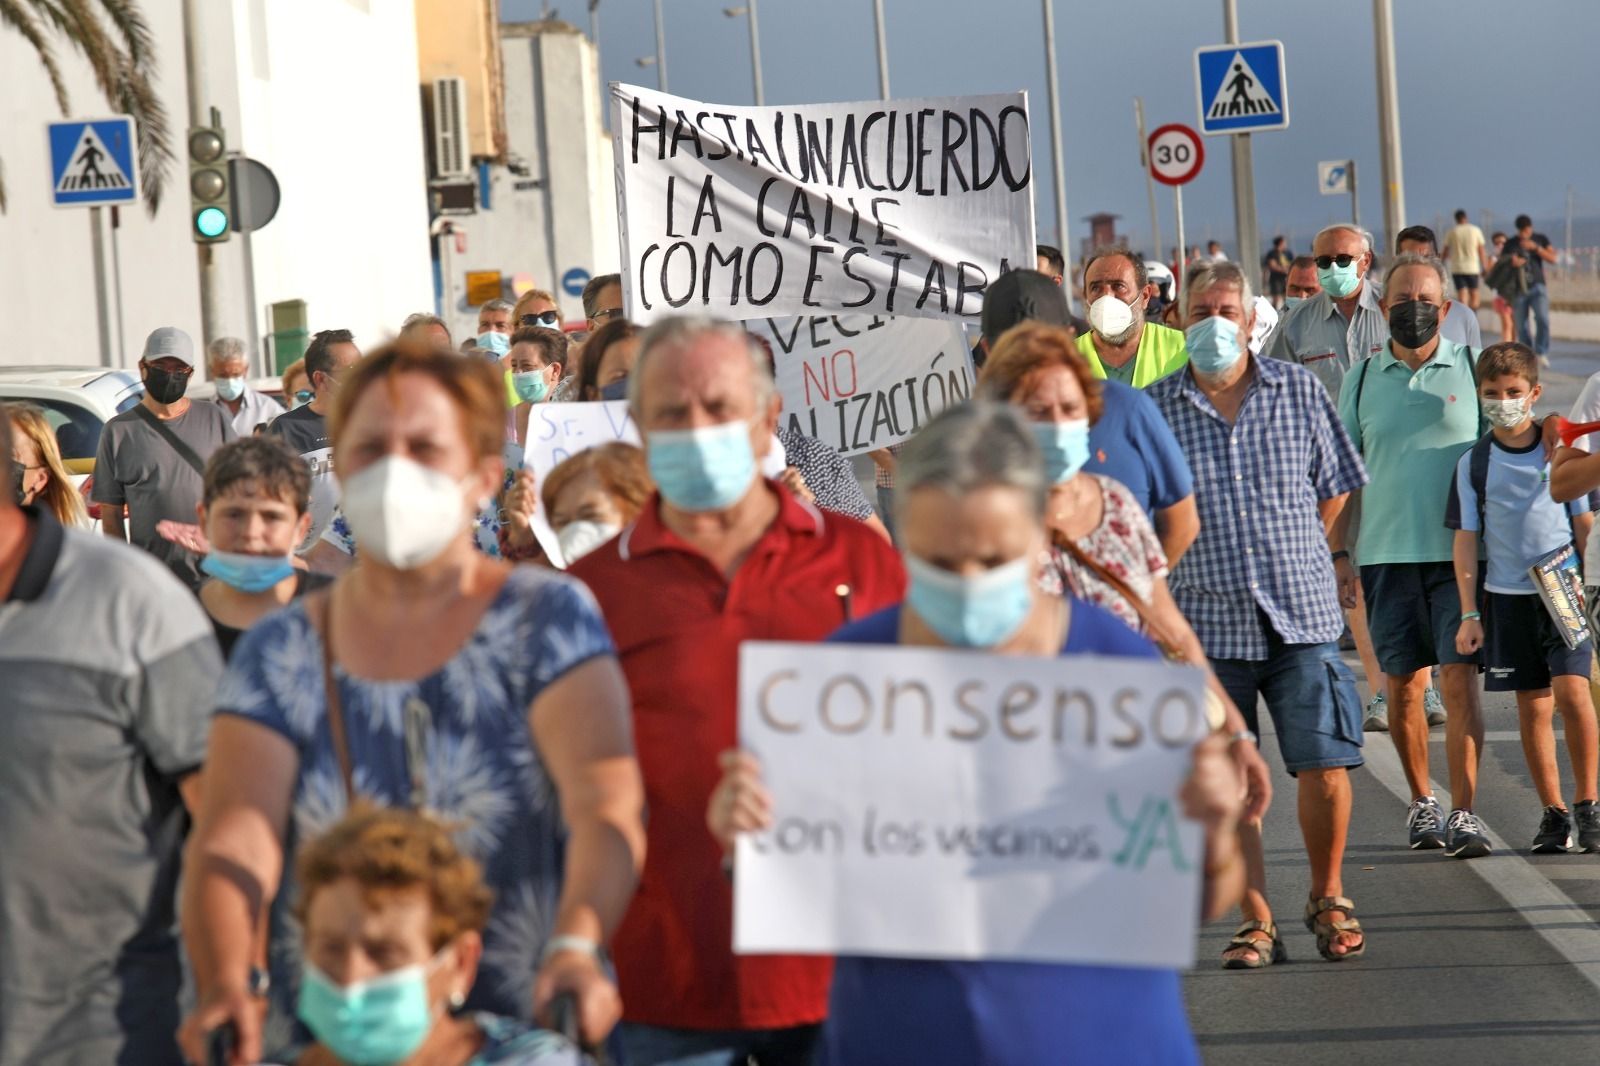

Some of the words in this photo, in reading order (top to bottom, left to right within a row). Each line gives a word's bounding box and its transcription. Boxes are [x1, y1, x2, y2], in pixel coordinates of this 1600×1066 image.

[632, 96, 781, 168] HASTA
[1157, 144, 1190, 165] 30
[667, 174, 722, 238] LA
[757, 176, 900, 246] CALLE
[639, 241, 784, 310] COMO
[802, 245, 1011, 317] ESTAB
[803, 349, 857, 406] NO
[861, 803, 927, 858] los
[1107, 790, 1193, 872] YA
